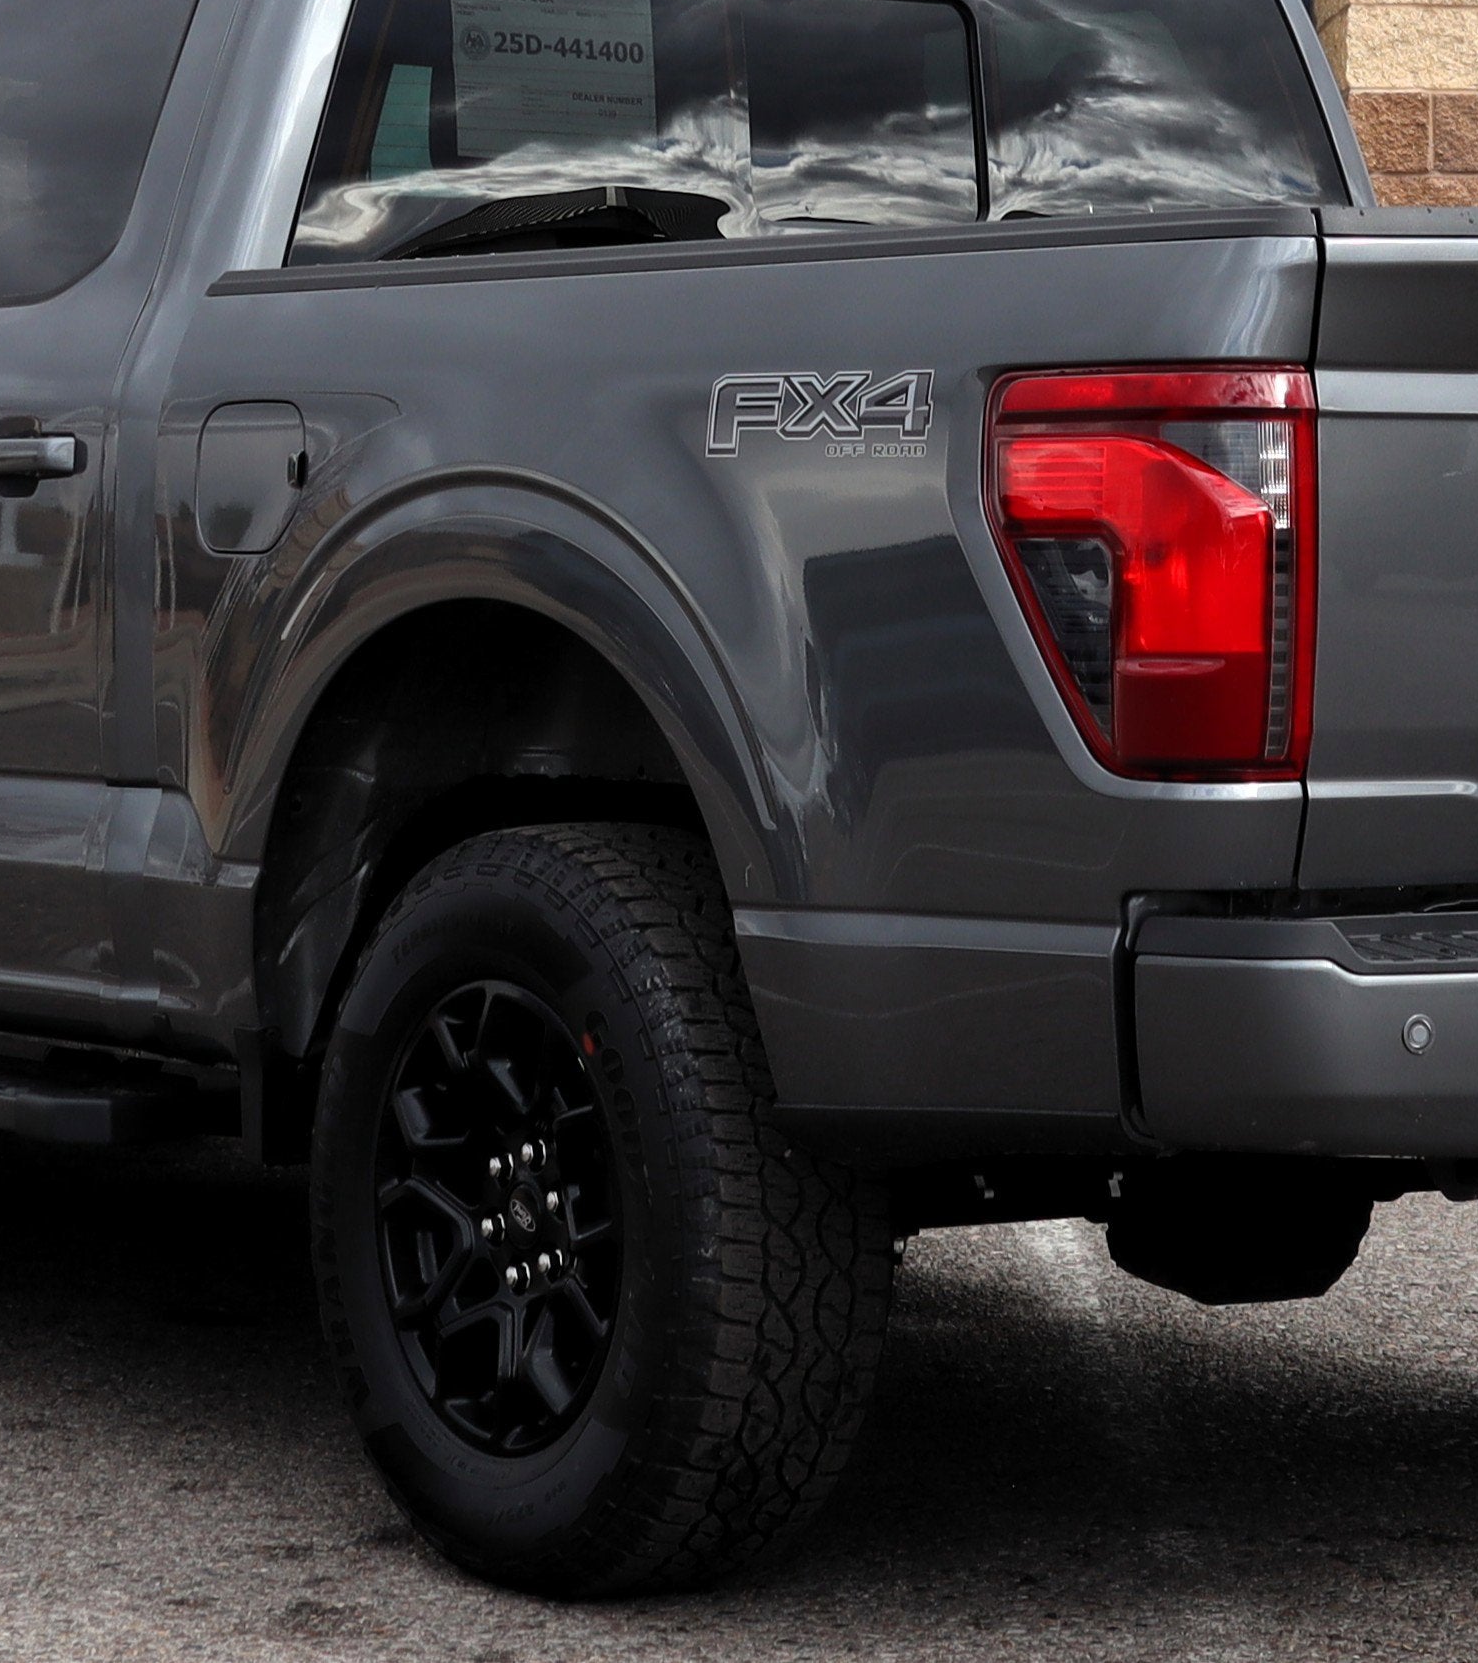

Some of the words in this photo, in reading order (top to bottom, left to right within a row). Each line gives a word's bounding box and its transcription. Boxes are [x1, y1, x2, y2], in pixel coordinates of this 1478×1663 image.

[493, 31, 645, 65] 25D-441400
[571, 91, 605, 104] DEALER
[606, 93, 643, 106] NUMBER
[705, 368, 935, 458] FX4
[824, 443, 866, 458] OFF
[871, 443, 926, 458] ROAD
